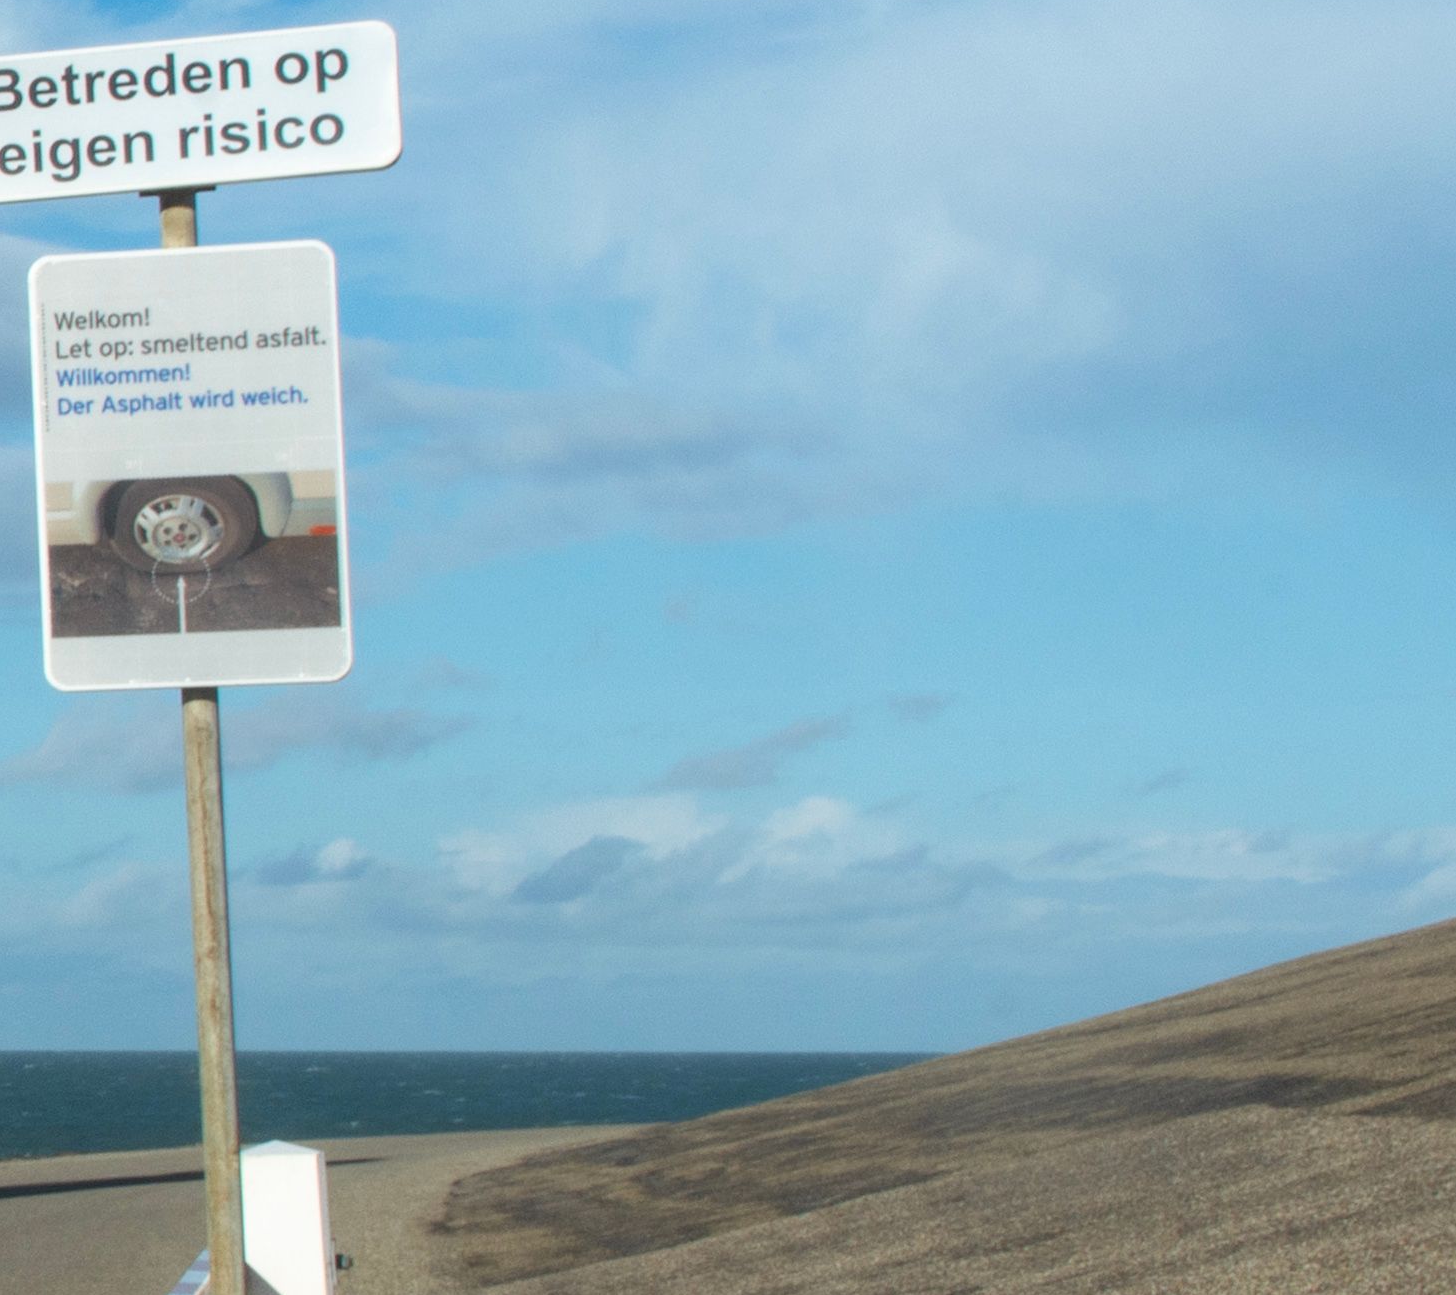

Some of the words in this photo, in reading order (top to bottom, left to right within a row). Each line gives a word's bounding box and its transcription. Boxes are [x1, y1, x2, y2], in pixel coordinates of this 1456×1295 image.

[275, 47, 350, 93] op
[179, 108, 345, 159] risico
[54, 307, 150, 331] Welkom!
[55, 338, 93, 360] Let
[99, 340, 134, 361] op:
[141, 329, 249, 355] smeltend
[256, 326, 327, 349] asfalt.
[56, 363, 191, 387] Willkommen!
[57, 397, 95, 416] Der
[101, 391, 183, 416] Asphalt
[189, 389, 235, 409] wird
[241, 385, 309, 406] weich.
